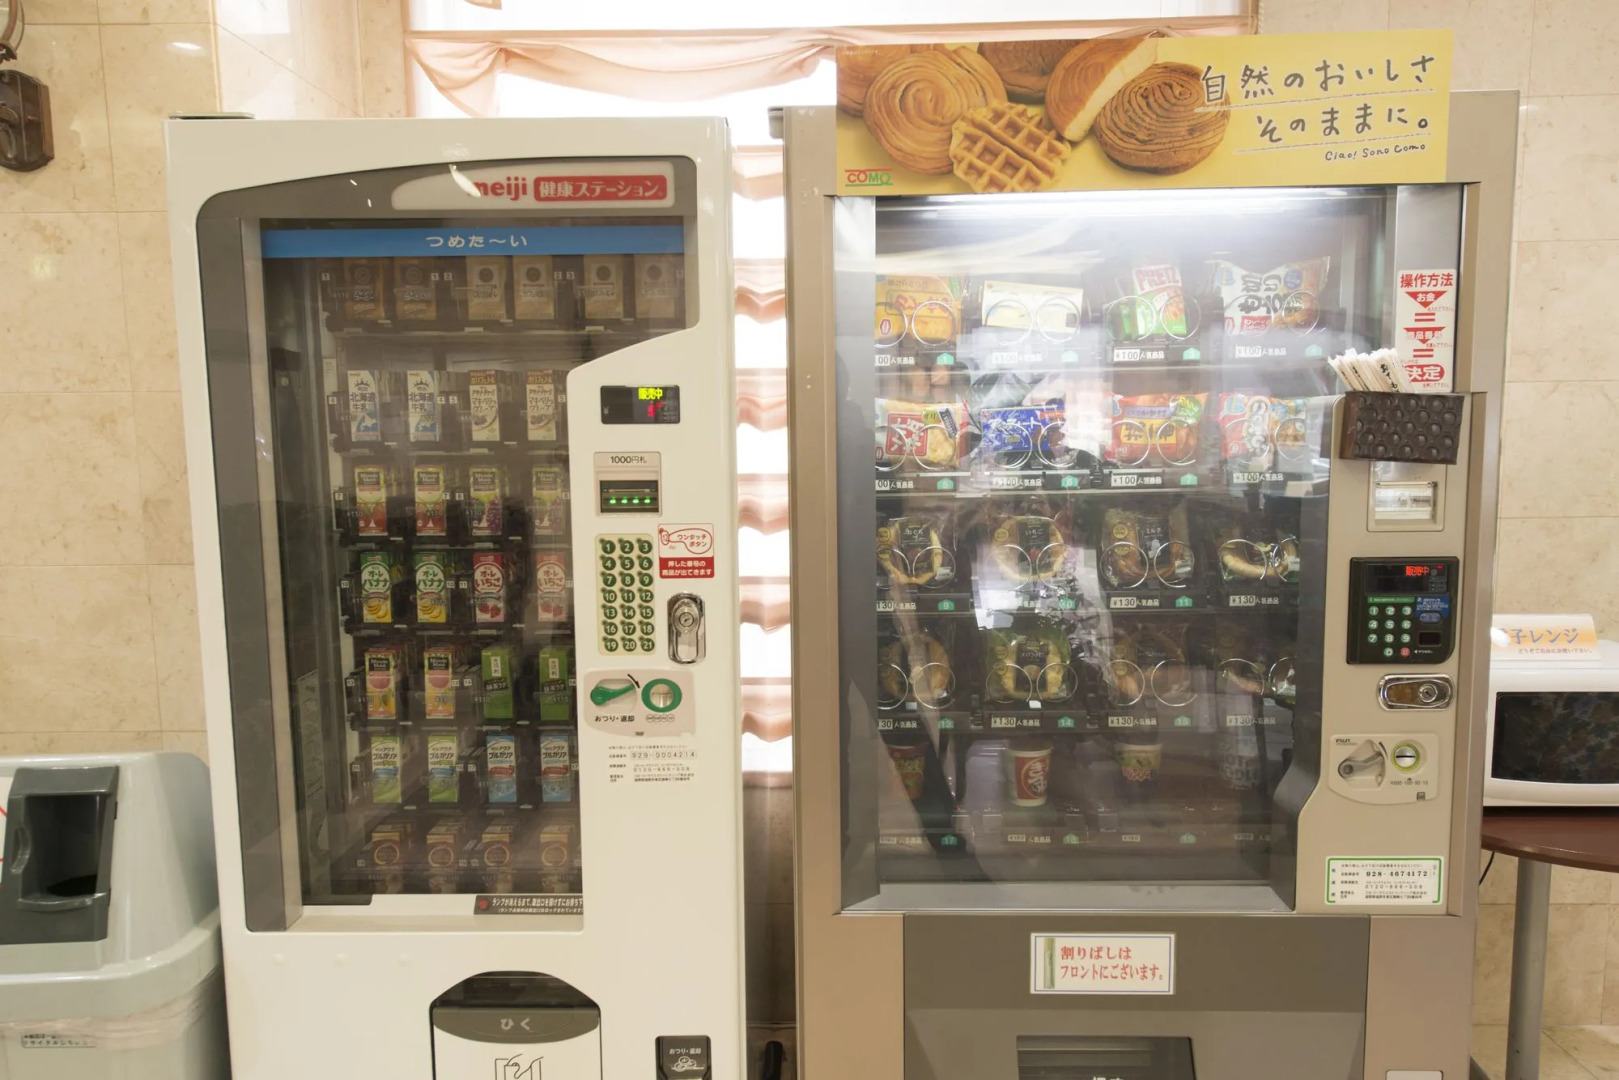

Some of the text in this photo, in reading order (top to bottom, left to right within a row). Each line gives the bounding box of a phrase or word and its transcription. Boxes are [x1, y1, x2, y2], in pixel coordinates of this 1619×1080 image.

[1202, 55, 1434, 102] 自然のおいしさ
[1257, 103, 1428, 143] そのままに。
[1325, 144, 1426, 161] Ciao! Sono Como
[847, 170, 892, 185] COMO
[467, 176, 527, 200] meiji
[539, 180, 660, 198] 健康ステーション
[1400, 273, 1454, 288] 操作方法
[1417, 292, 1435, 302] お金
[1409, 366, 1441, 380] 決定
[350, 392, 375, 403] 北海道
[409, 392, 434, 403] 北海道
[352, 403, 367, 411] 牛乳
[411, 403, 426, 411] 牛乳
[610, 456, 647, 464] 1000円札
[363, 578, 389, 587] バナナ
[417, 578, 443, 587] バナナ
[476, 578, 501, 587] いちご
[539, 578, 563, 587] いちご
[1500, 628, 1578, 644] 子レンジ
[1017, 719, 1040, 727] 人気商品
[1061, 946, 1132, 960] 割りばしは
[1060, 963, 1163, 980] フロントにございます。
[501, 1018, 531, 1031] ひく
[669, 1047, 701, 1055] おつり・返却
